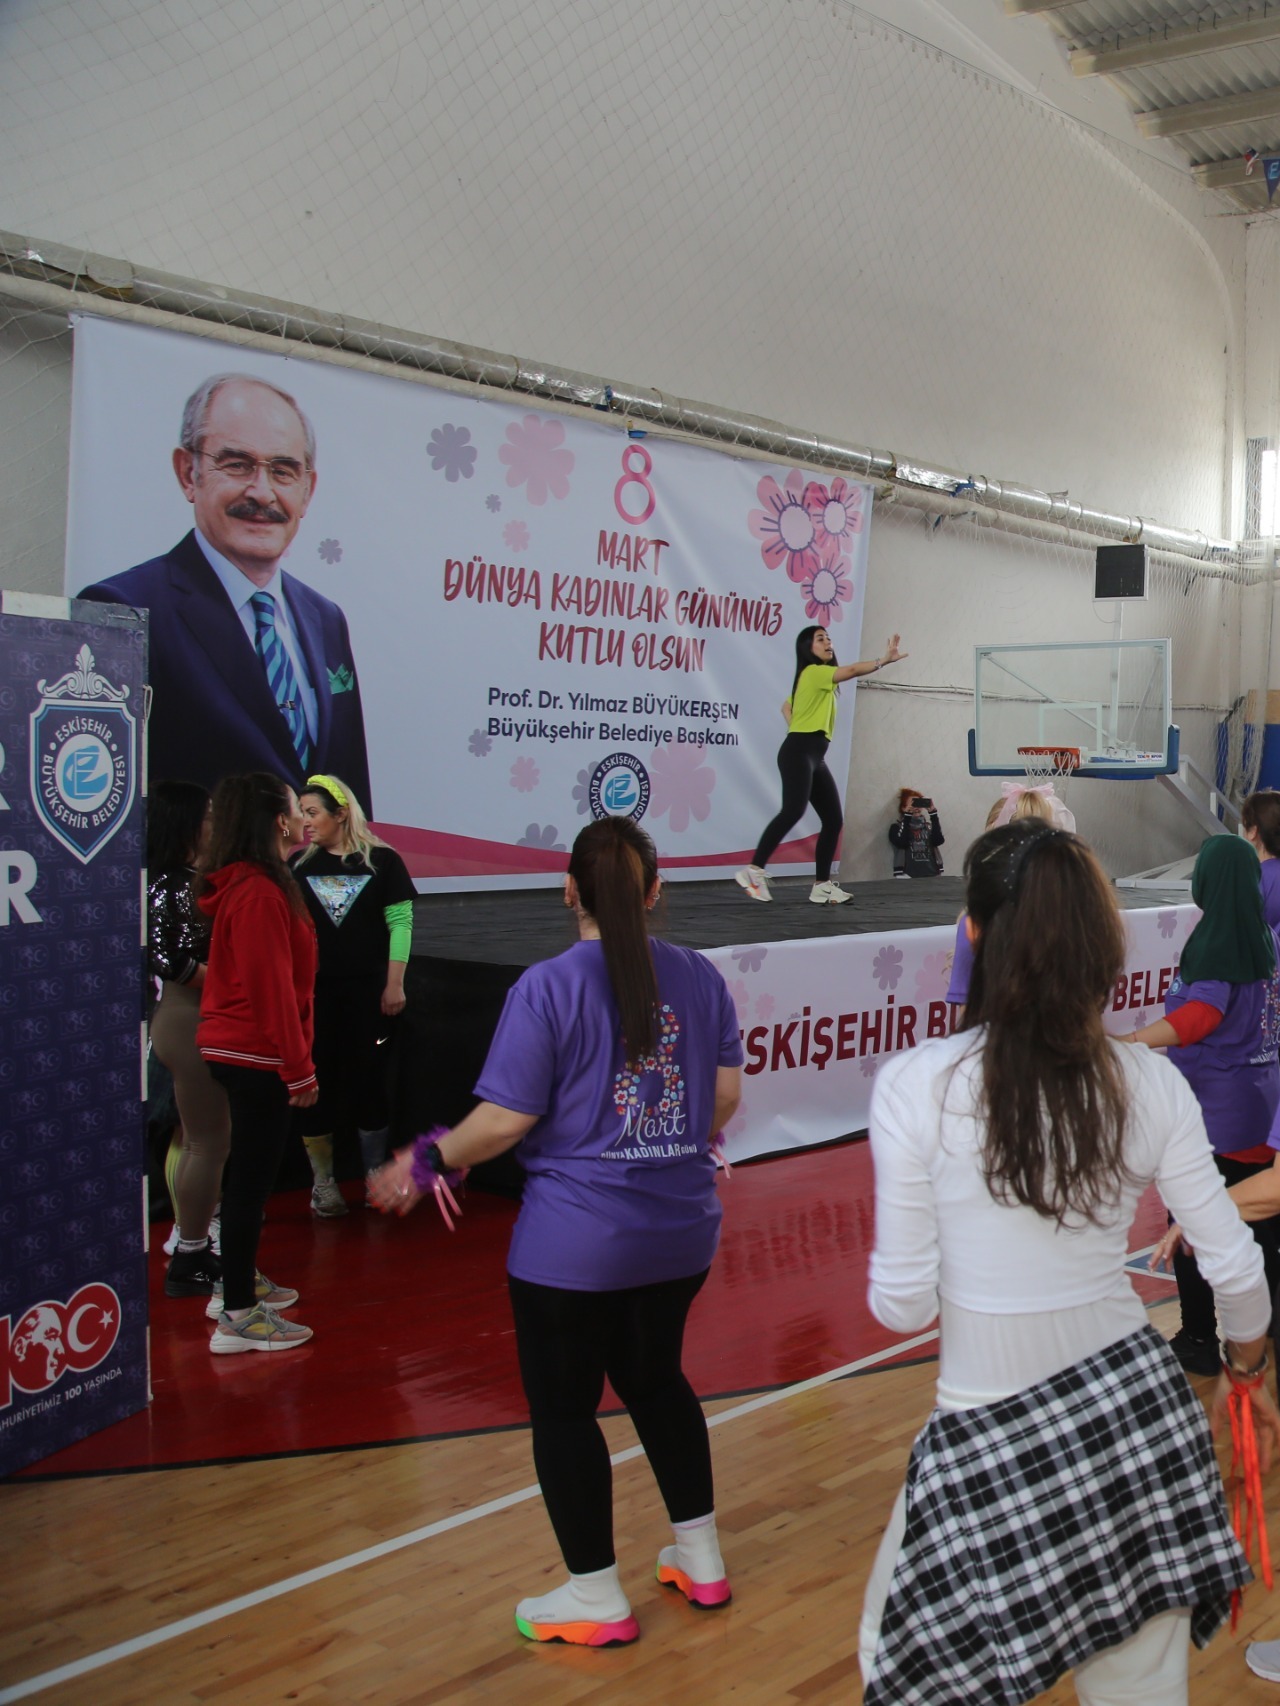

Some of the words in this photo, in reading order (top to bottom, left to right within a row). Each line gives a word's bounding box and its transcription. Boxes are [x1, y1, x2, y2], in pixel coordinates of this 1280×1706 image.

[614, 444, 656, 526] 8
[597, 530, 670, 576] MART
[444, 555, 541, 610] DÜNYA
[551, 572, 669, 624] KADINLAR
[675, 587, 783, 636] GÜNÜNÜZ
[538, 621, 626, 668] KUTLU
[631, 632, 706, 673] OLSUN
[488, 687, 533, 708] Prof.
[538, 690, 564, 710] Dr.
[568, 692, 628, 713] Yılmaz
[632, 693, 739, 723] BÜYÜKERŞEN
[55, 715, 113, 743] ESKİŞEHİR
[487, 717, 595, 744] Büyükşehir
[599, 722, 673, 747] Belediye
[677, 726, 739, 749] Başkanı
[601, 754, 641, 772] ESKİŞEHİR
[42, 754, 89, 829] BÜYÜKŞEHİR
[92, 755, 126, 827] BELEDİYESİ
[739, 994, 917, 1076] SKİŞEHİR
[614, 1101, 686, 1147] Mart
[623, 1143, 682, 1160] KADINLAR
[64, 1385, 82, 1400] 100
[84, 1367, 122, 1392] YAŞINDA
